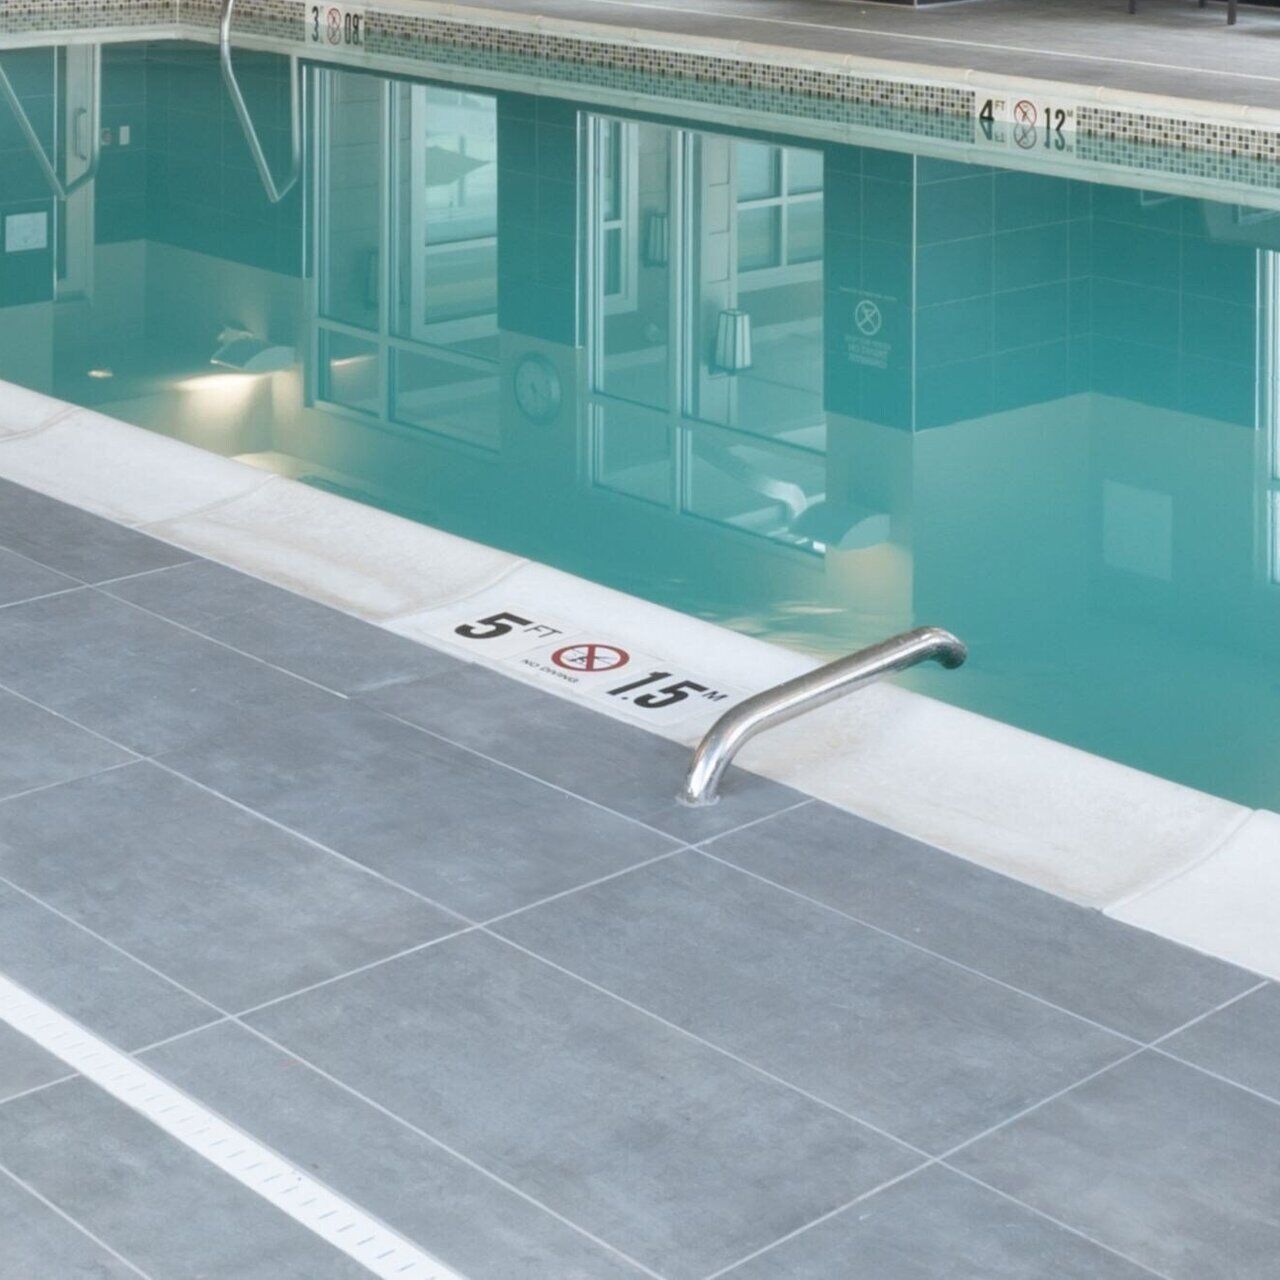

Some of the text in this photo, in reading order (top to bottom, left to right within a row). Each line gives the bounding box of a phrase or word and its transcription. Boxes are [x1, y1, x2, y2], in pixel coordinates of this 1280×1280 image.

[979, 99, 994, 121] 4
[454, 611, 564, 639] 5 FT
[606, 672, 729, 708] 1.5 M
